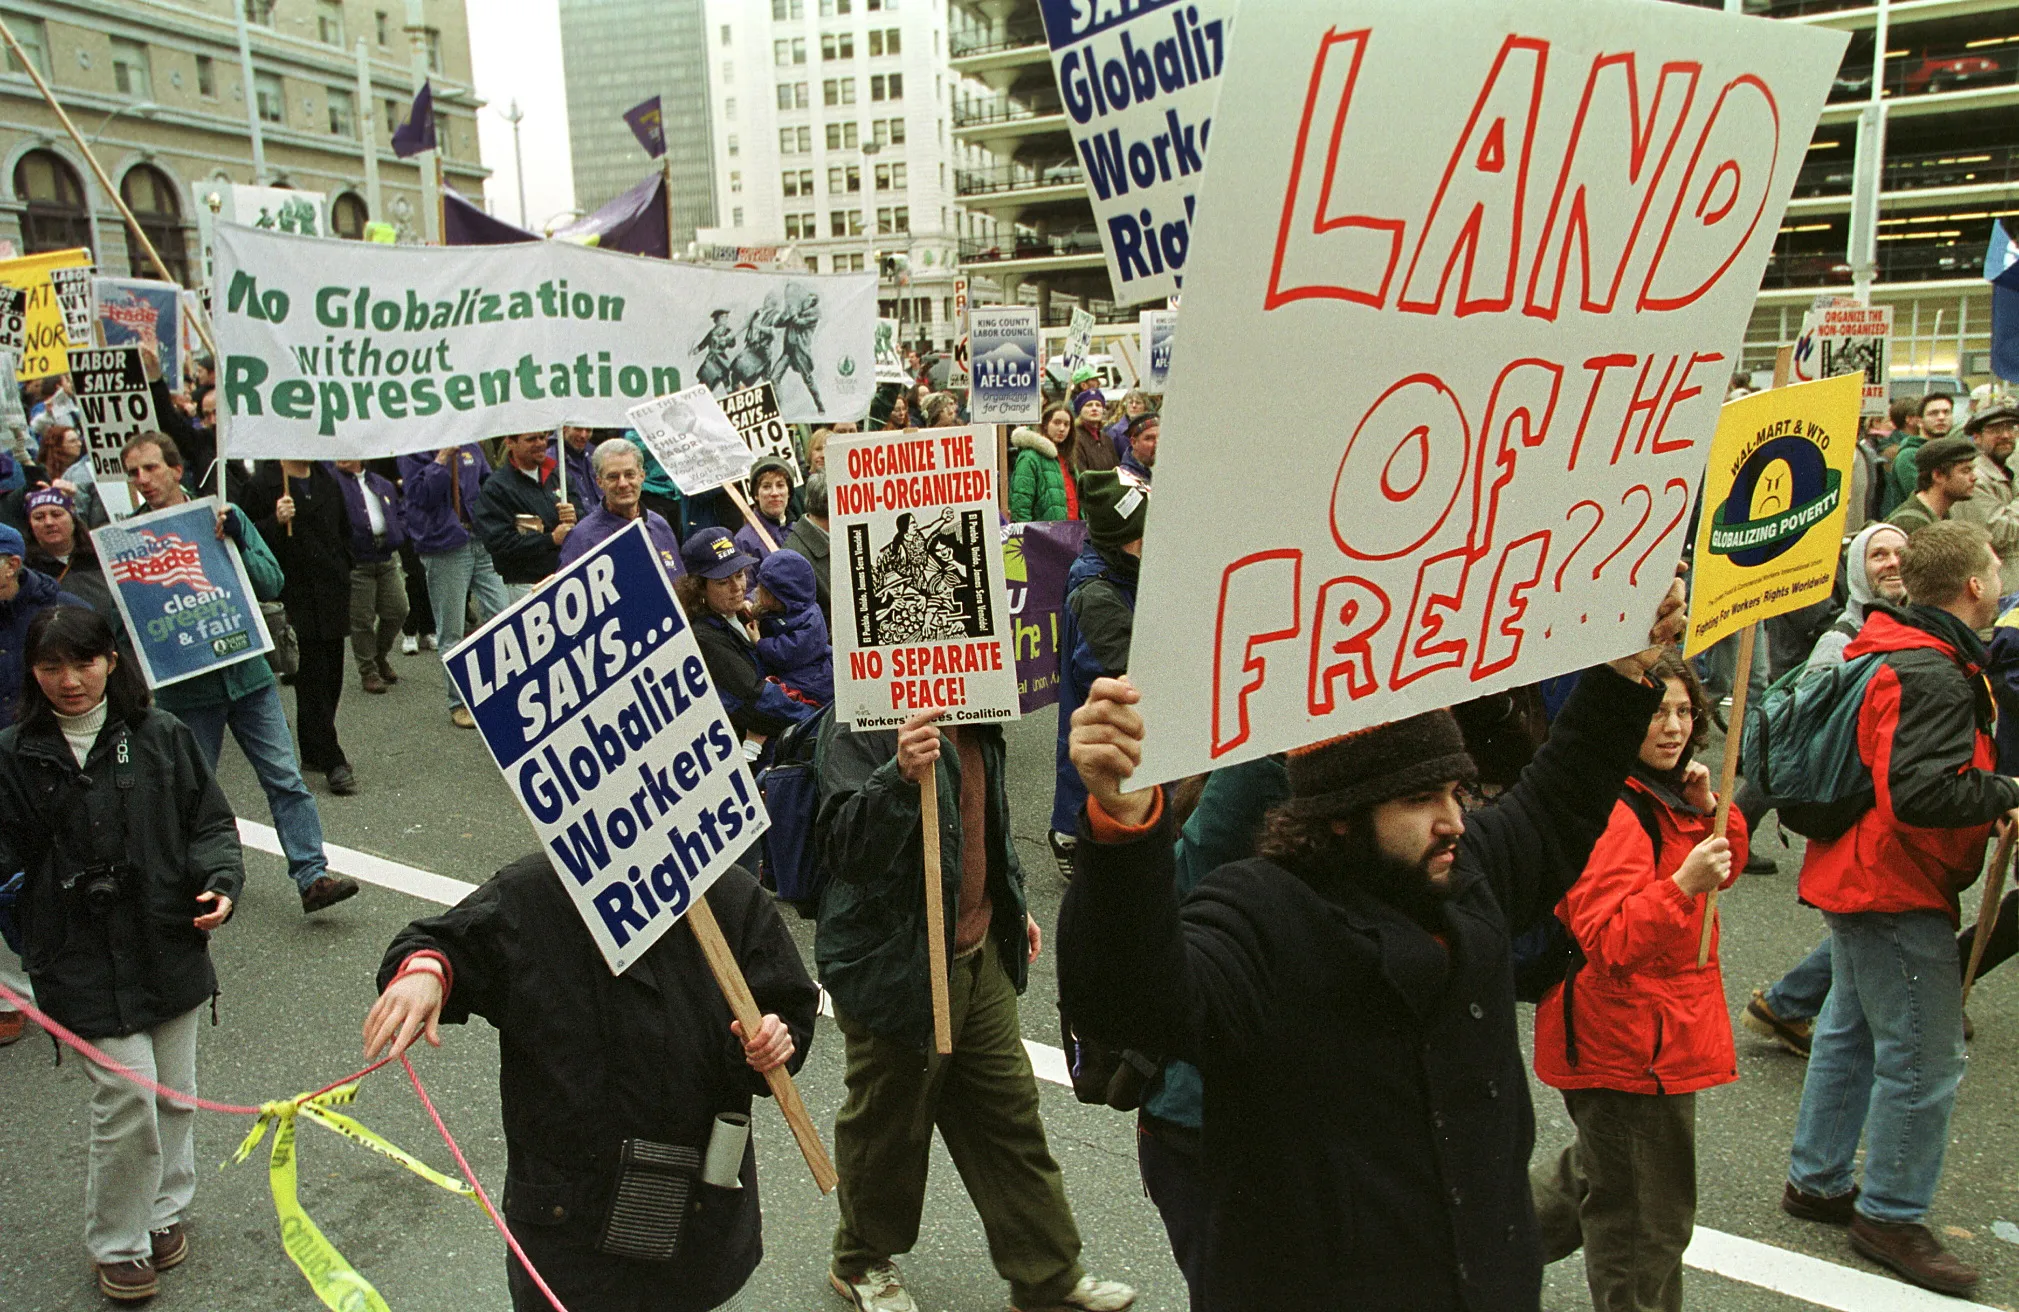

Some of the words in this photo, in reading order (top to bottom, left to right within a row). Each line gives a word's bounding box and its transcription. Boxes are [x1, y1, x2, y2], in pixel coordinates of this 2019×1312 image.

[1060, 4, 1230, 124] Globaliz
[1263, 24, 1779, 323] LAND
[1107, 194, 1195, 289] Rig
[227, 269, 290, 324] No
[315, 279, 626, 332] Globalization
[1825, 310, 1865, 323] ORGANIZE
[1868, 310, 1883, 322] THE
[973, 329, 999, 338] LABOR
[1000, 328, 1034, 338] COUNCIL
[977, 319, 997, 327] KING
[998, 318, 1030, 327] COUNTY
[1817, 323, 1889, 336] NON-ORGANIZED!
[70, 351, 127, 373] LABOR
[289, 335, 454, 377] without
[83, 370, 145, 393] SAYS...
[224, 351, 682, 437] Representation
[980, 373, 1031, 388] AFL-CIO
[982, 392, 1029, 404] Organizing
[79, 393, 150, 425] WTO
[982, 403, 998, 415] for
[998, 403, 1031, 414] Change
[647, 429, 666, 442] NO
[653, 431, 687, 450] CHILD
[1730, 419, 1792, 477] WAL-MART
[1793, 419, 1803, 434] &
[1806, 422, 1831, 451] WTO
[91, 450, 126, 475] Dem
[847, 439, 936, 480] ORGANIZE
[940, 435, 975, 469] THE
[1329, 357, 1564, 563] OF
[1567, 351, 1724, 471] THE
[31, 495, 65, 507] SEIU
[836, 468, 992, 516] NON-ORGANIZED!
[1711, 522, 1778, 548] GLOBALIZING
[1779, 488, 1838, 535] POVERTY
[717, 547, 736, 560] SEIU
[163, 586, 231, 615] clean,
[1695, 614, 1719, 638] Fighting
[1719, 609, 1731, 621] For
[1763, 587, 1790, 603] Rights
[1791, 572, 1831, 594] Worldwide
[178, 632, 195, 646] &
[196, 612, 243, 640] fair
[464, 554, 621, 708] LABOR
[1010, 617, 1041, 661] he
[516, 615, 674, 742] SAYS...
[850, 649, 884, 681] NO
[891, 641, 1003, 677] SEPARATE
[890, 676, 967, 710] PEACE!
[856, 715, 908, 728] Workers'
[956, 707, 1012, 721] Coalition
[519, 653, 708, 825] Globalize
[549, 717, 733, 888] Workers
[593, 769, 757, 949] Rights!
